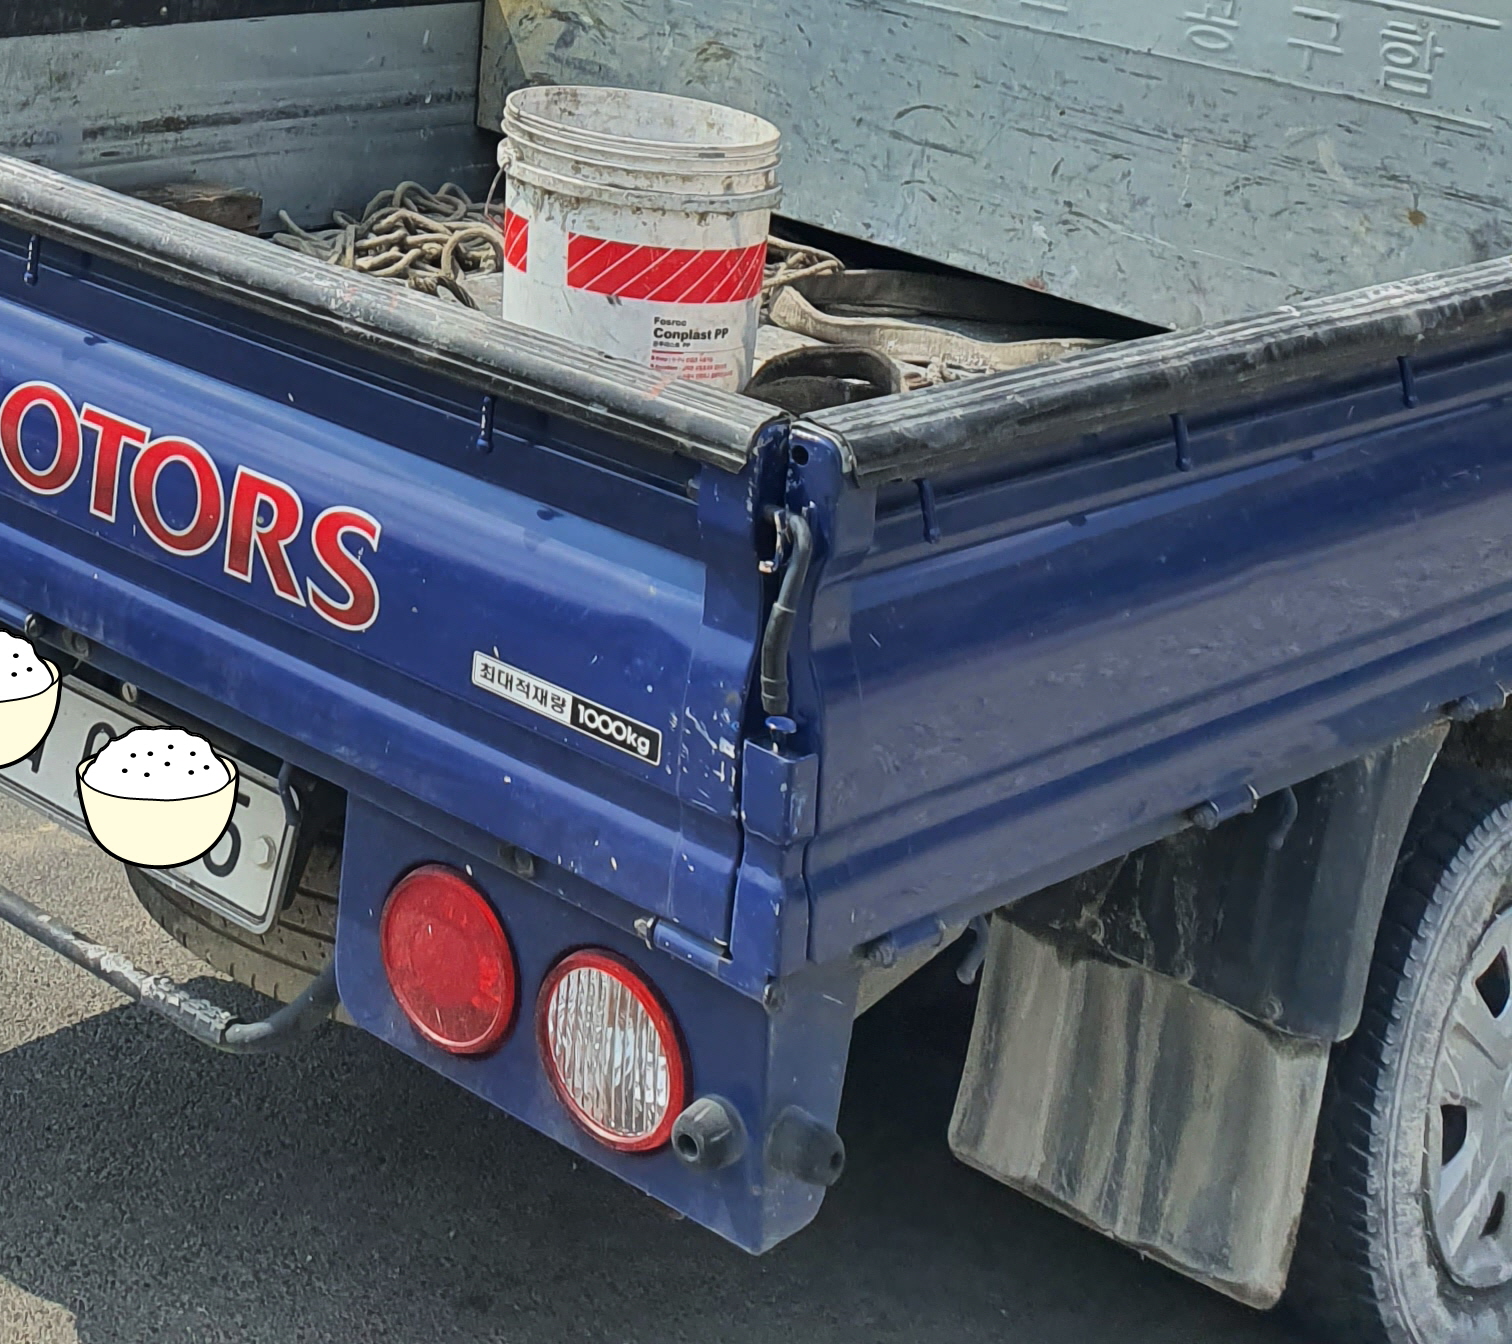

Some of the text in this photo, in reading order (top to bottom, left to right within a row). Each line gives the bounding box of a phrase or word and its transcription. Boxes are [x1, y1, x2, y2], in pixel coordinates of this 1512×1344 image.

[653, 316, 687, 327] Fosroc
[653, 327, 729, 343] Conplast PP
[479, 662, 651, 757] 최대적재량 1000kg
